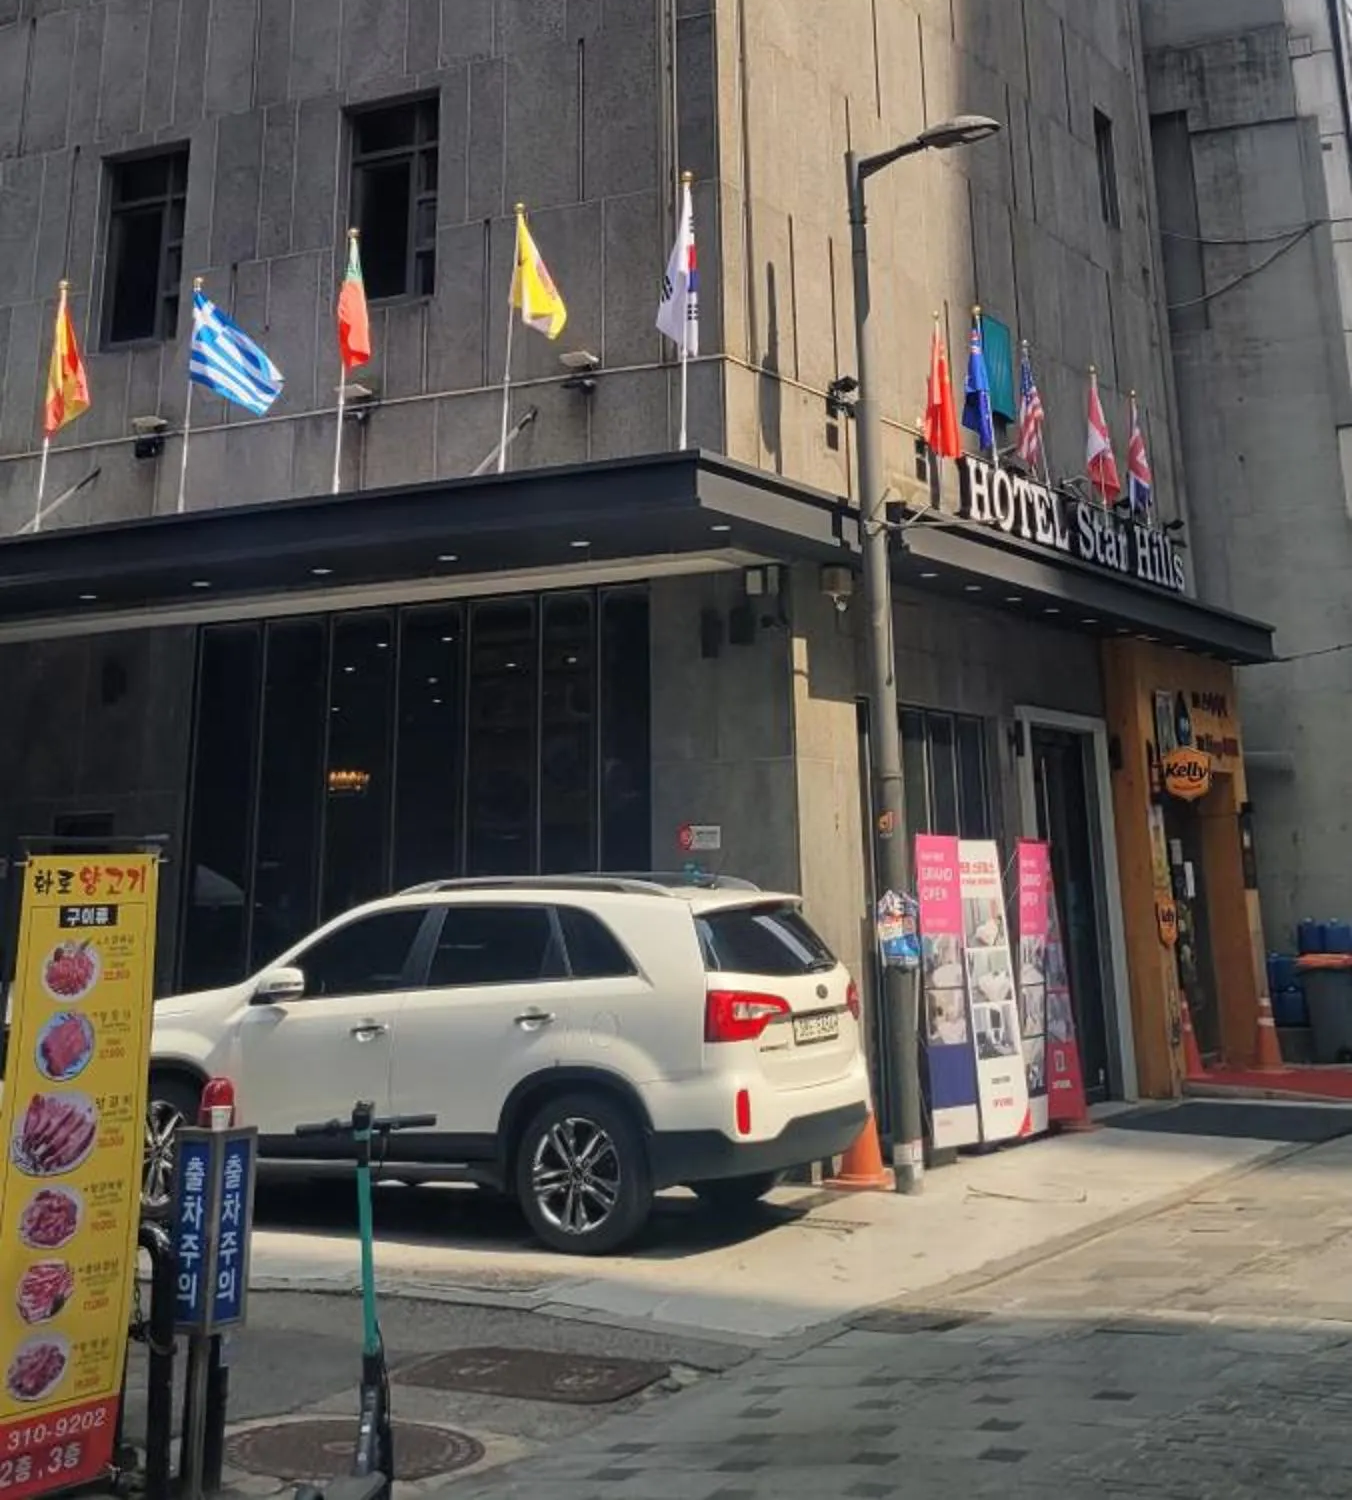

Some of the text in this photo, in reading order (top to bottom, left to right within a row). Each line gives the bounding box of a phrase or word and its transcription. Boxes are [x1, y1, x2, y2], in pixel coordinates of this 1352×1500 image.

[965, 458, 1186, 593] HOTEL Star Hills
[1165, 761, 1208, 783] Kelly
[34, 864, 147, 896] 화로 양고기
[177, 1156, 206, 1309] 출차주의
[216, 1154, 243, 1304] 출차주의
[7, 1407, 107, 1451] 310-9202
